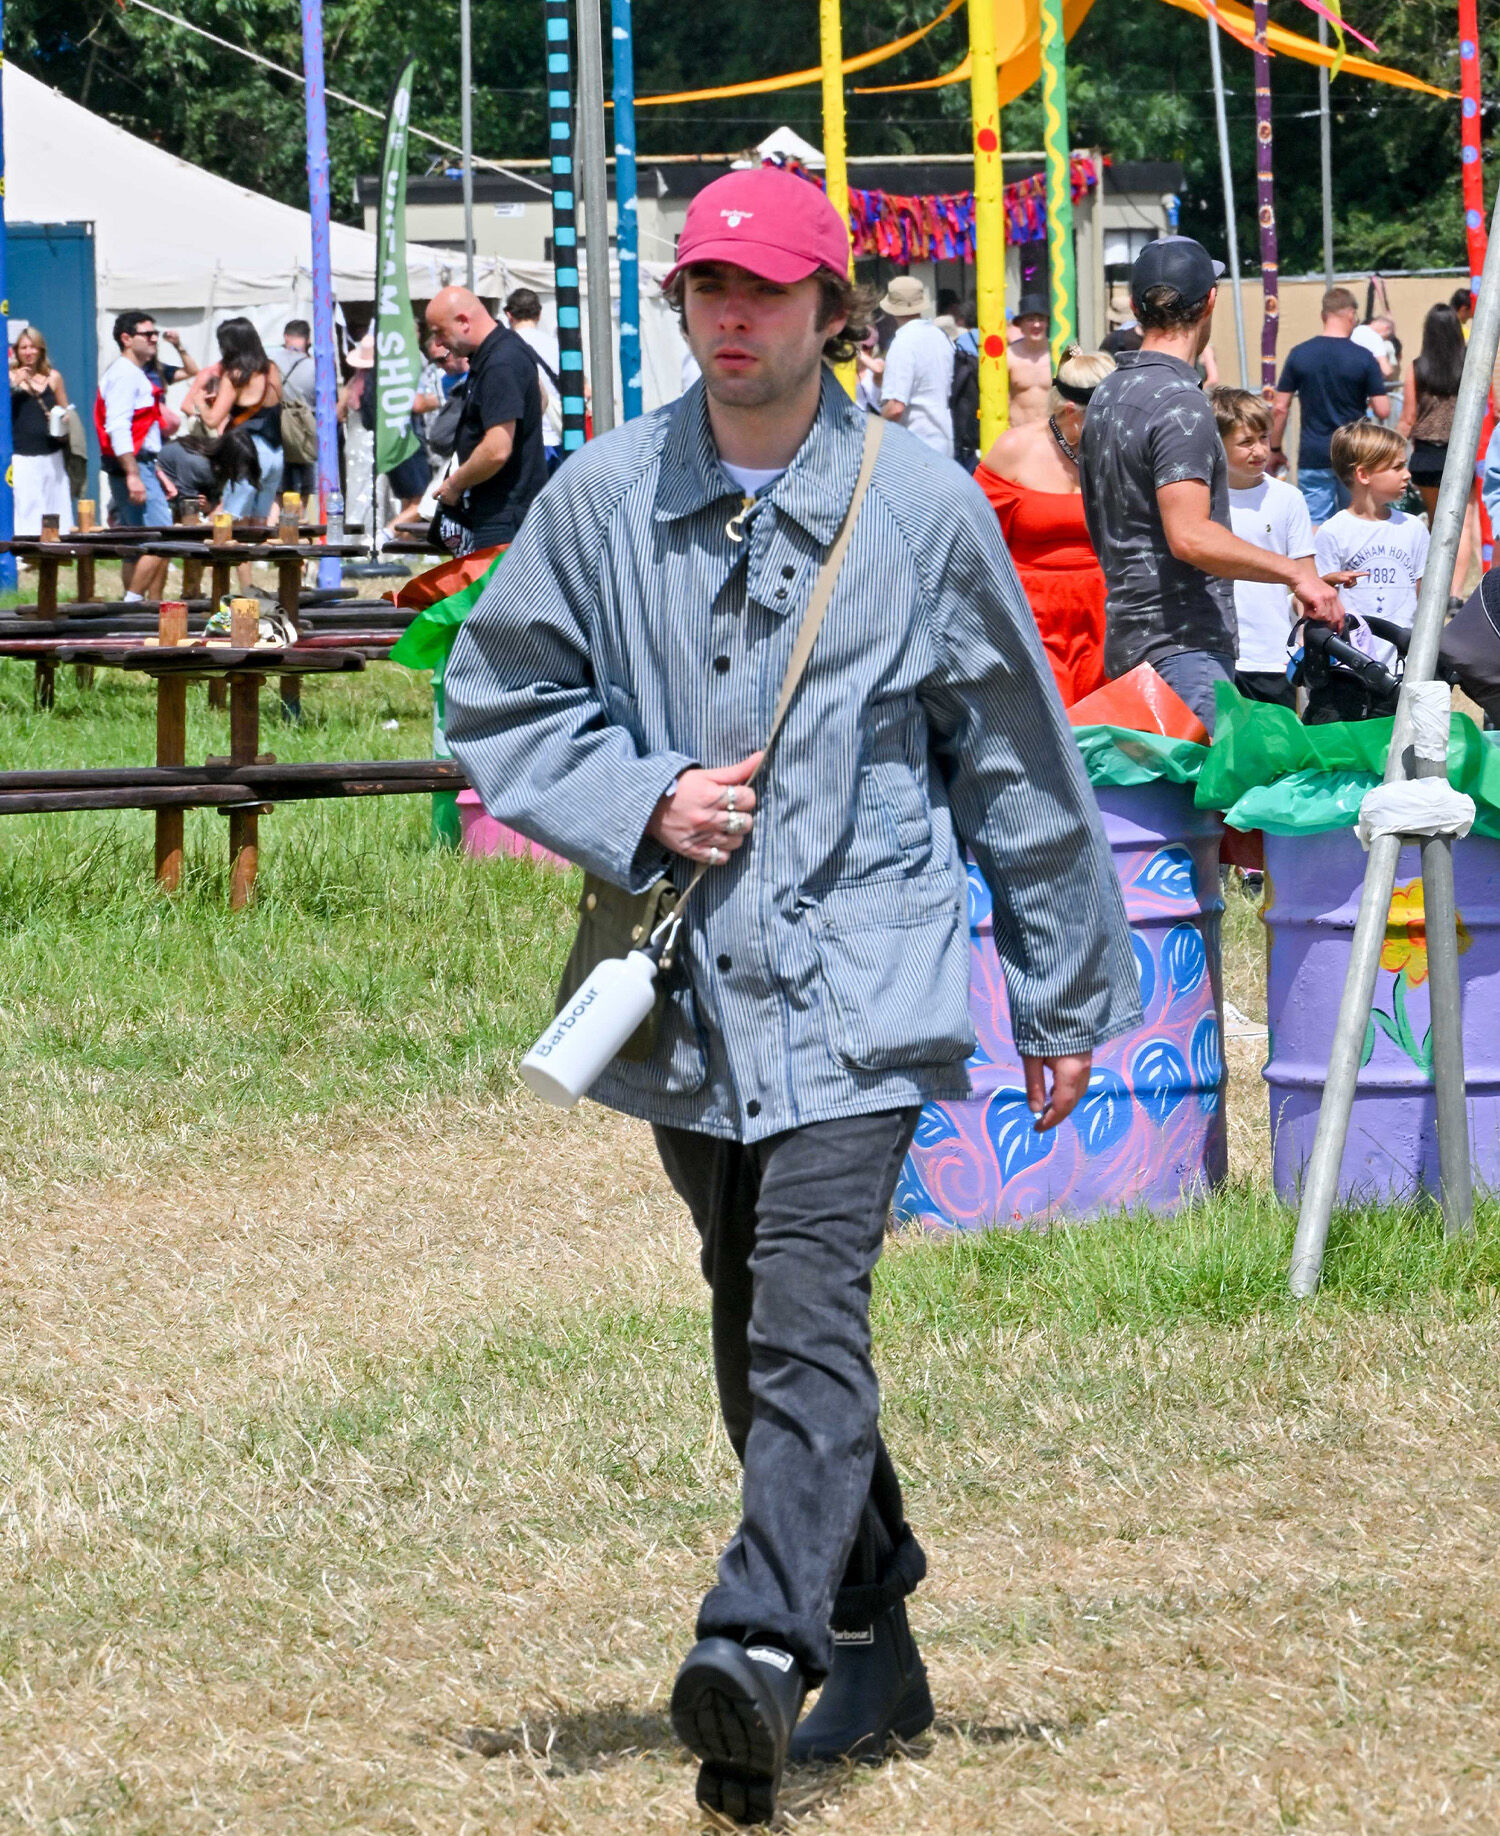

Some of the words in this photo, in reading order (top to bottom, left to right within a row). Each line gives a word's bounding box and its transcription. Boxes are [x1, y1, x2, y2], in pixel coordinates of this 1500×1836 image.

[1347, 545, 1385, 570] TENHAM
[1366, 568, 1396, 584] 1882
[536, 987, 598, 1057] Barbour
